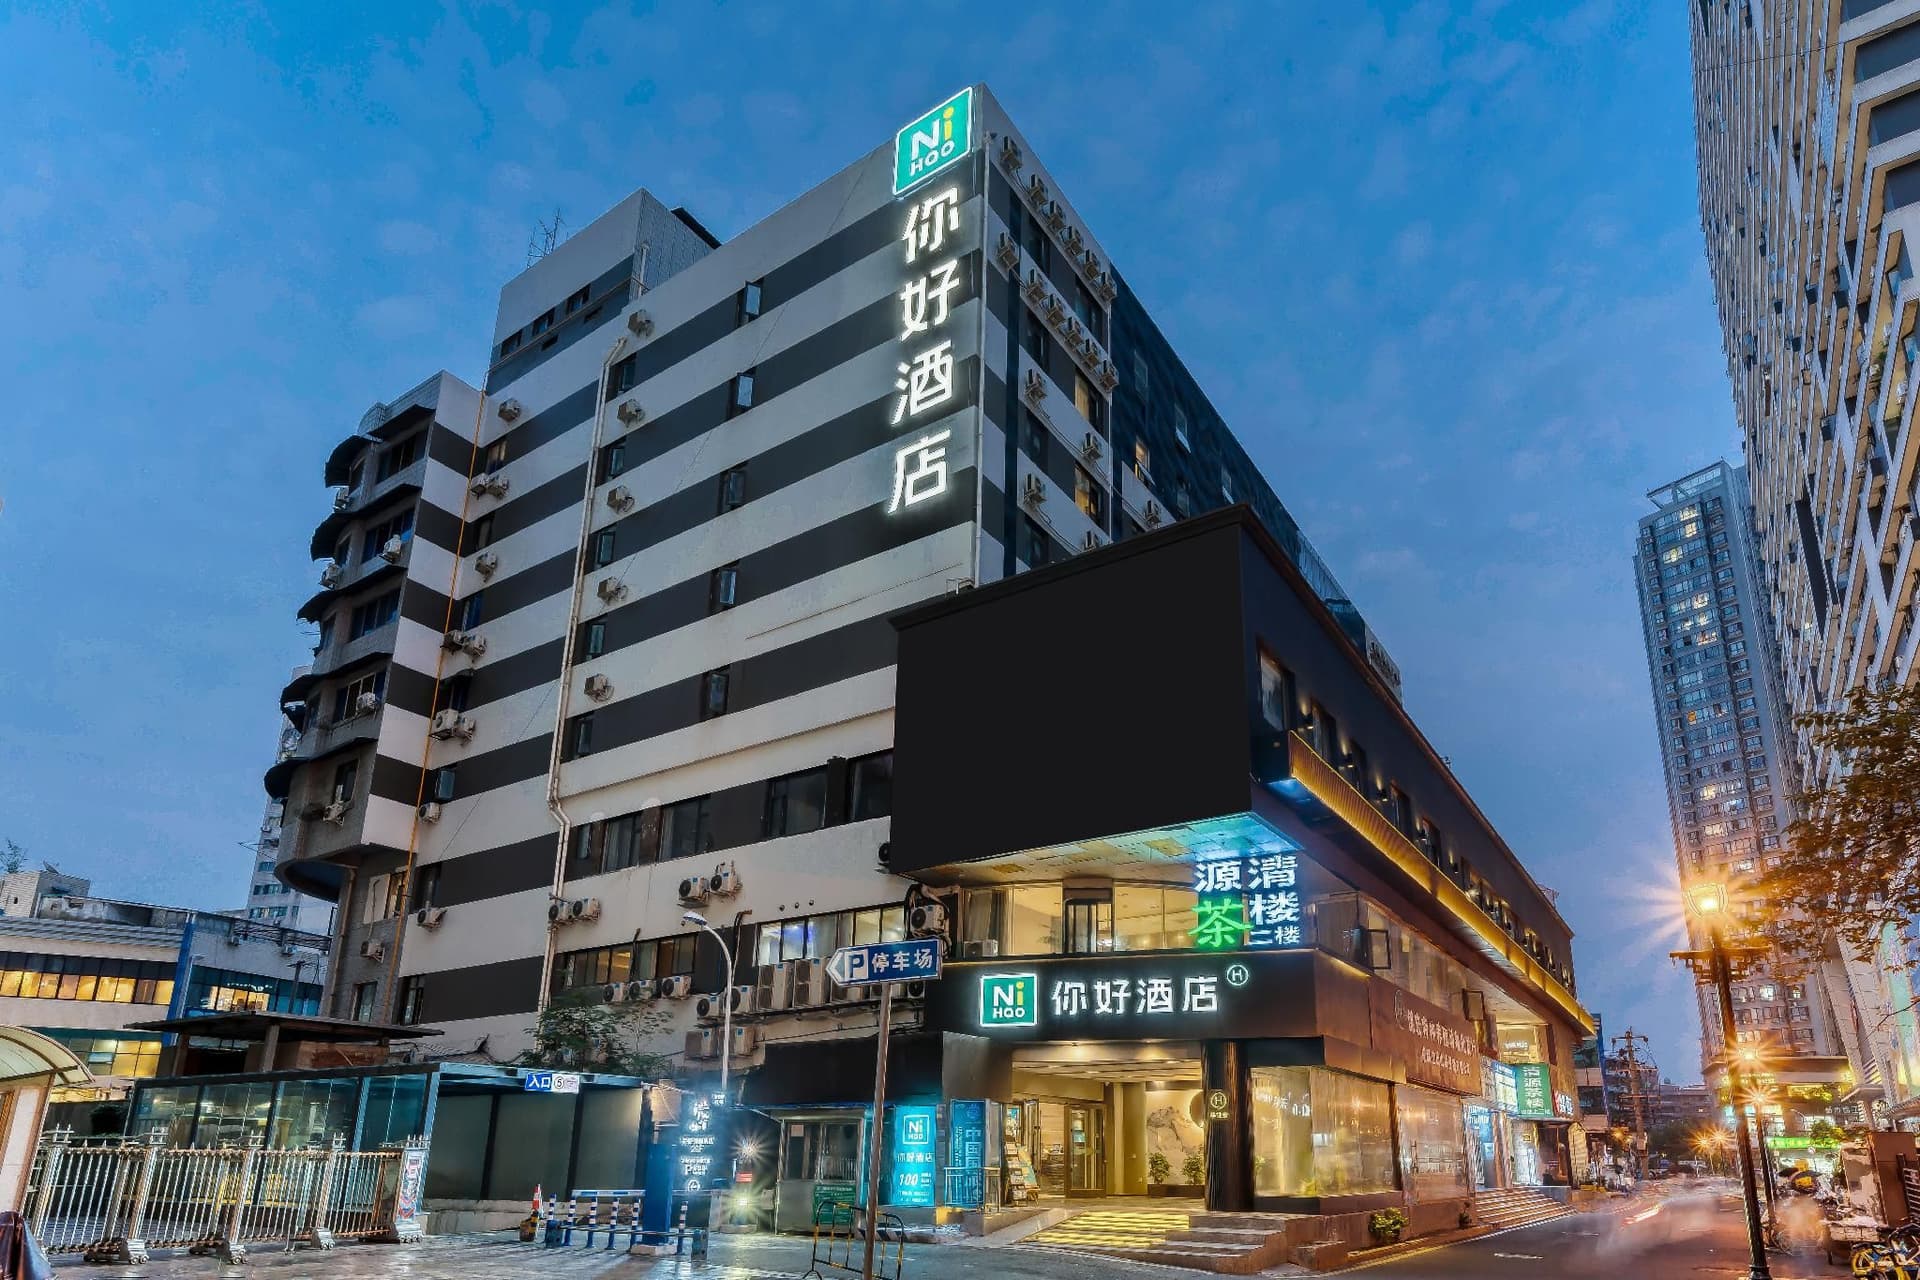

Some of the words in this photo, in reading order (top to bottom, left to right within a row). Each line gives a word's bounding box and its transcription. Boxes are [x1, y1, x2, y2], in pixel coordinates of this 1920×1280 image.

[911, 106, 954, 161] Ni
[888, 187, 960, 514] 你好酒店
[1248, 926, 1300, 945] 二楼
[872, 949, 933, 973] 停车场
[994, 982, 1024, 1007] Ni
[1052, 976, 1219, 1016] 你好酒店
[528, 1076, 551, 1089] 入口
[908, 1119, 923, 1133] Ni
[899, 1173, 919, 1187] 100
